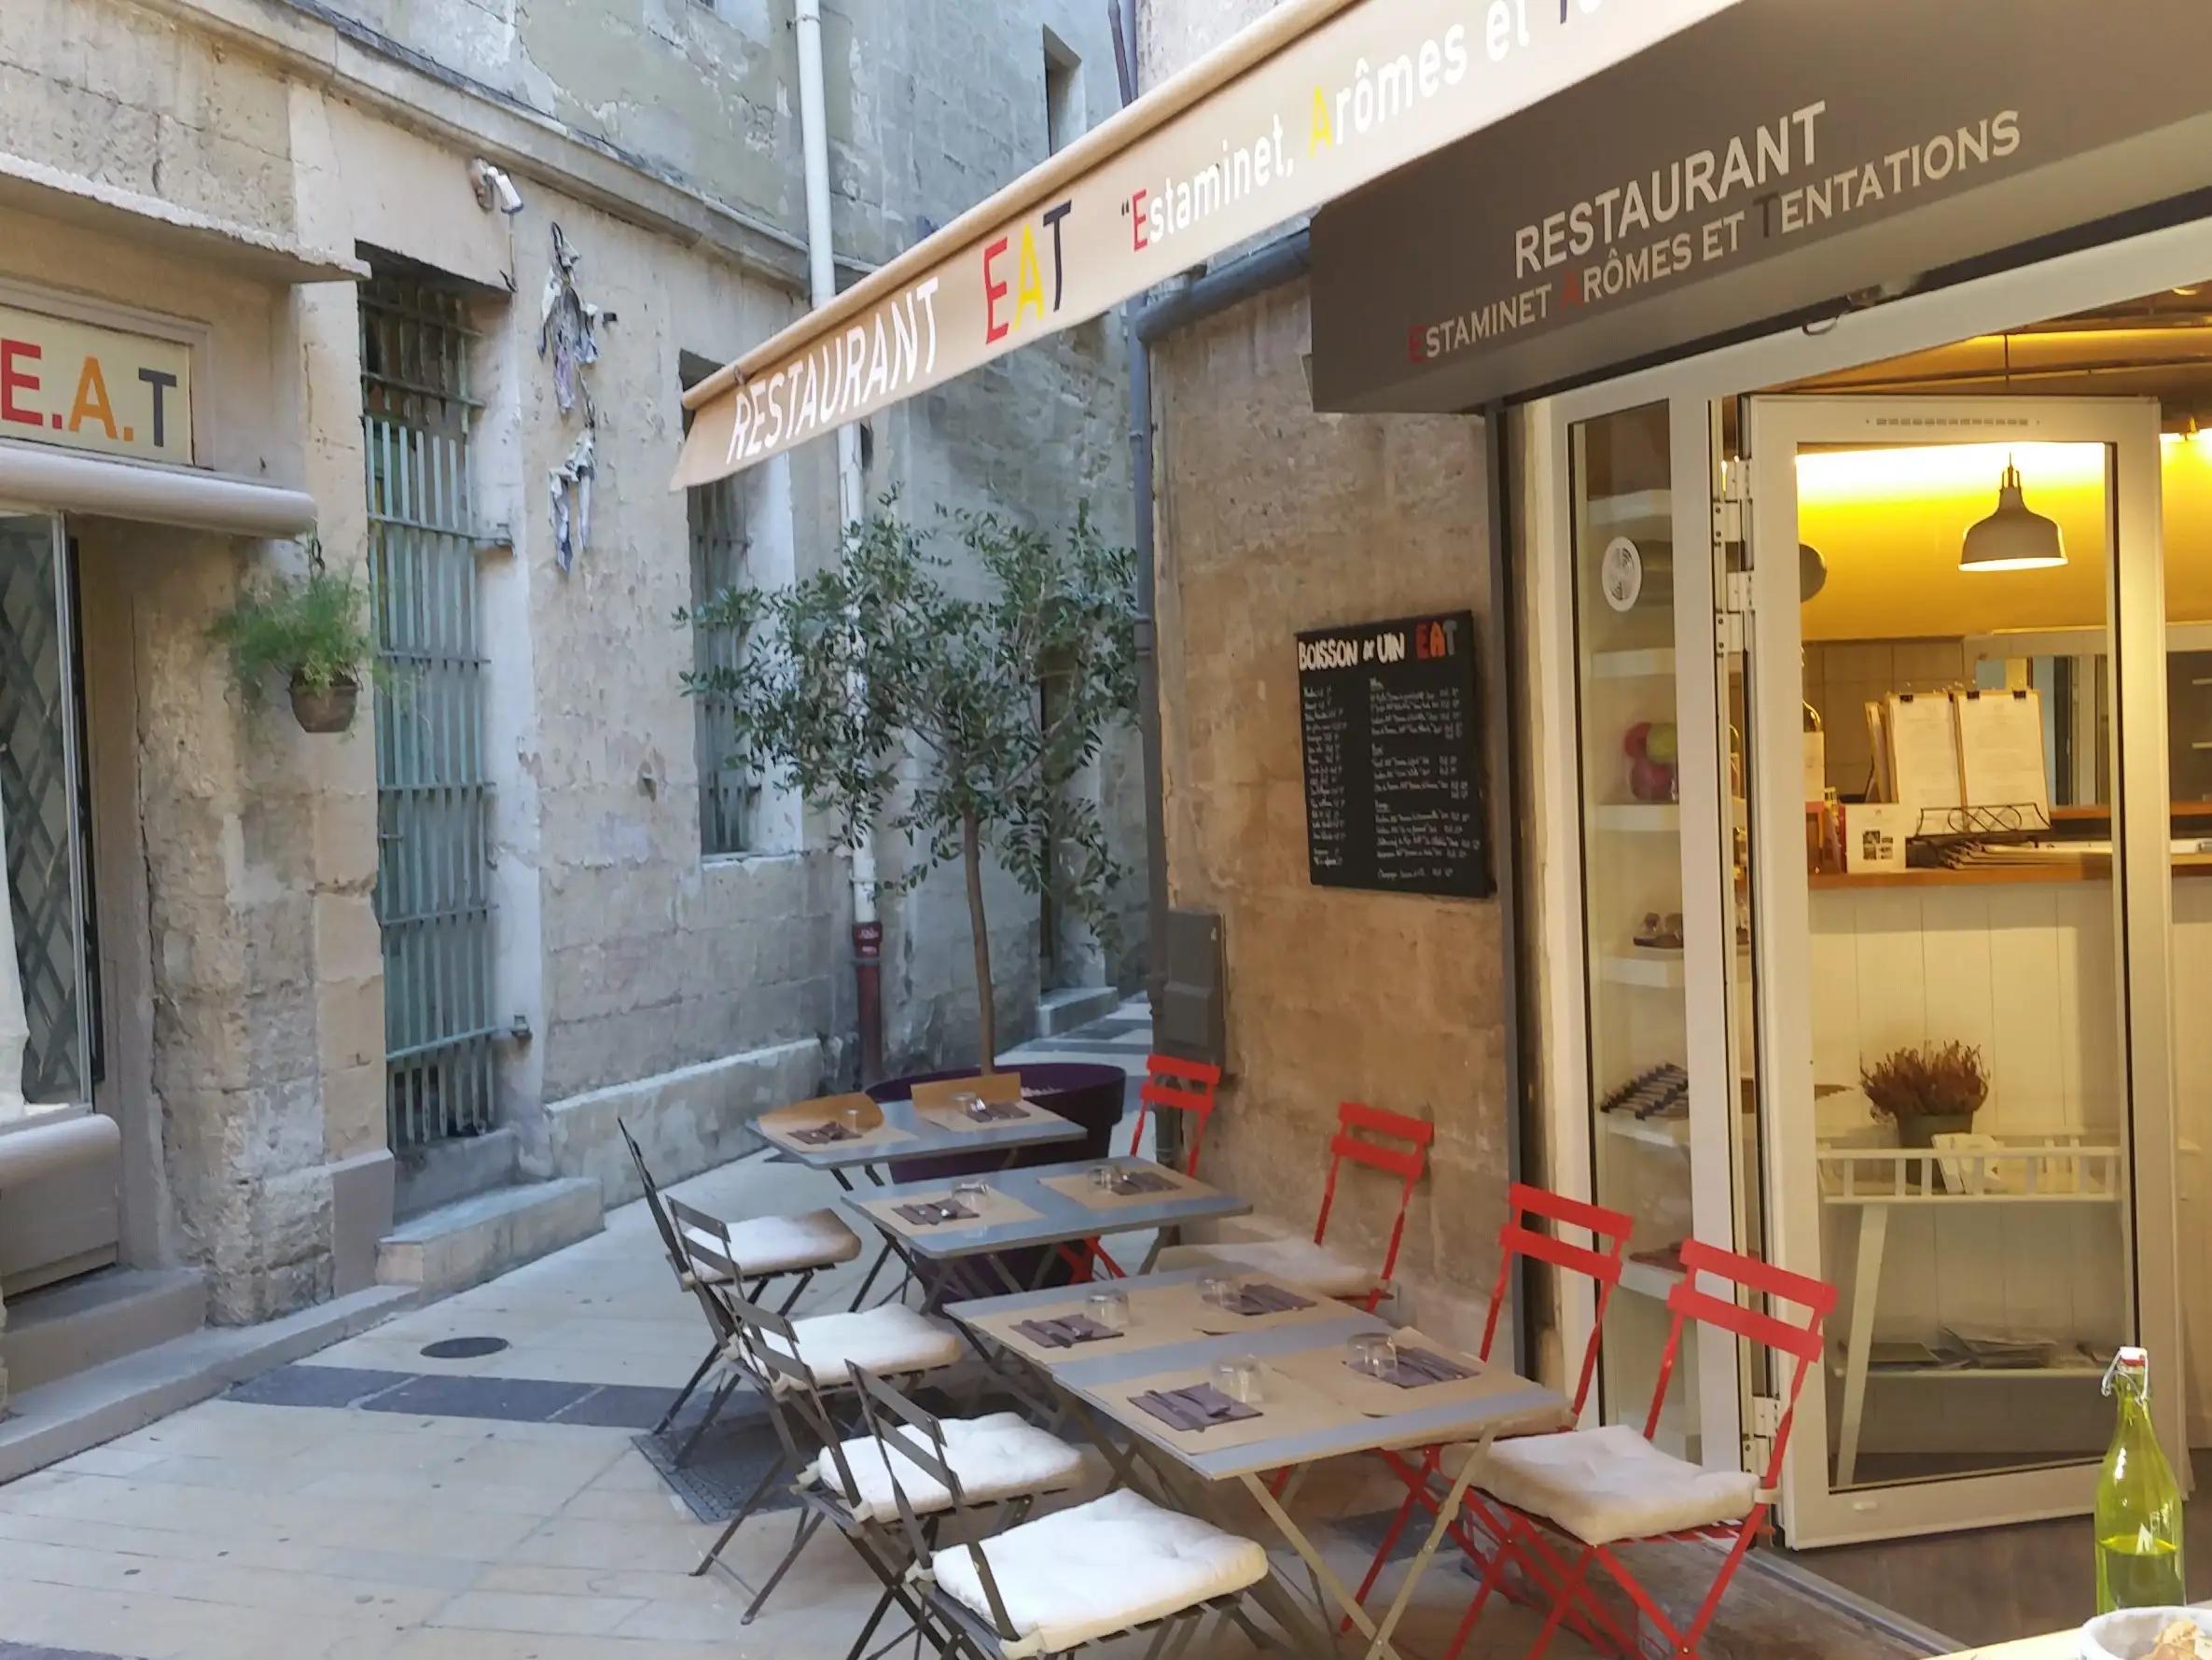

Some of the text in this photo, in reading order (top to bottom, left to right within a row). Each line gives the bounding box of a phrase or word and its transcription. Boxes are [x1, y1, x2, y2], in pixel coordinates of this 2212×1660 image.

[726, 276, 939, 466] RESTAURANT
[983, 199, 1072, 345] EAT
[1307, 23, 1468, 159] Arômes
[1486, 0, 1530, 62] et
[1408, 109, 2021, 363] ESTAMINET ARÔMES ET TENTATIONS
[1515, 99, 1827, 279] RESTAURANT
[0, 338, 177, 449] E.A.T
[1298, 638, 1359, 672] BOISSON
[1414, 620, 1458, 661] EAT
